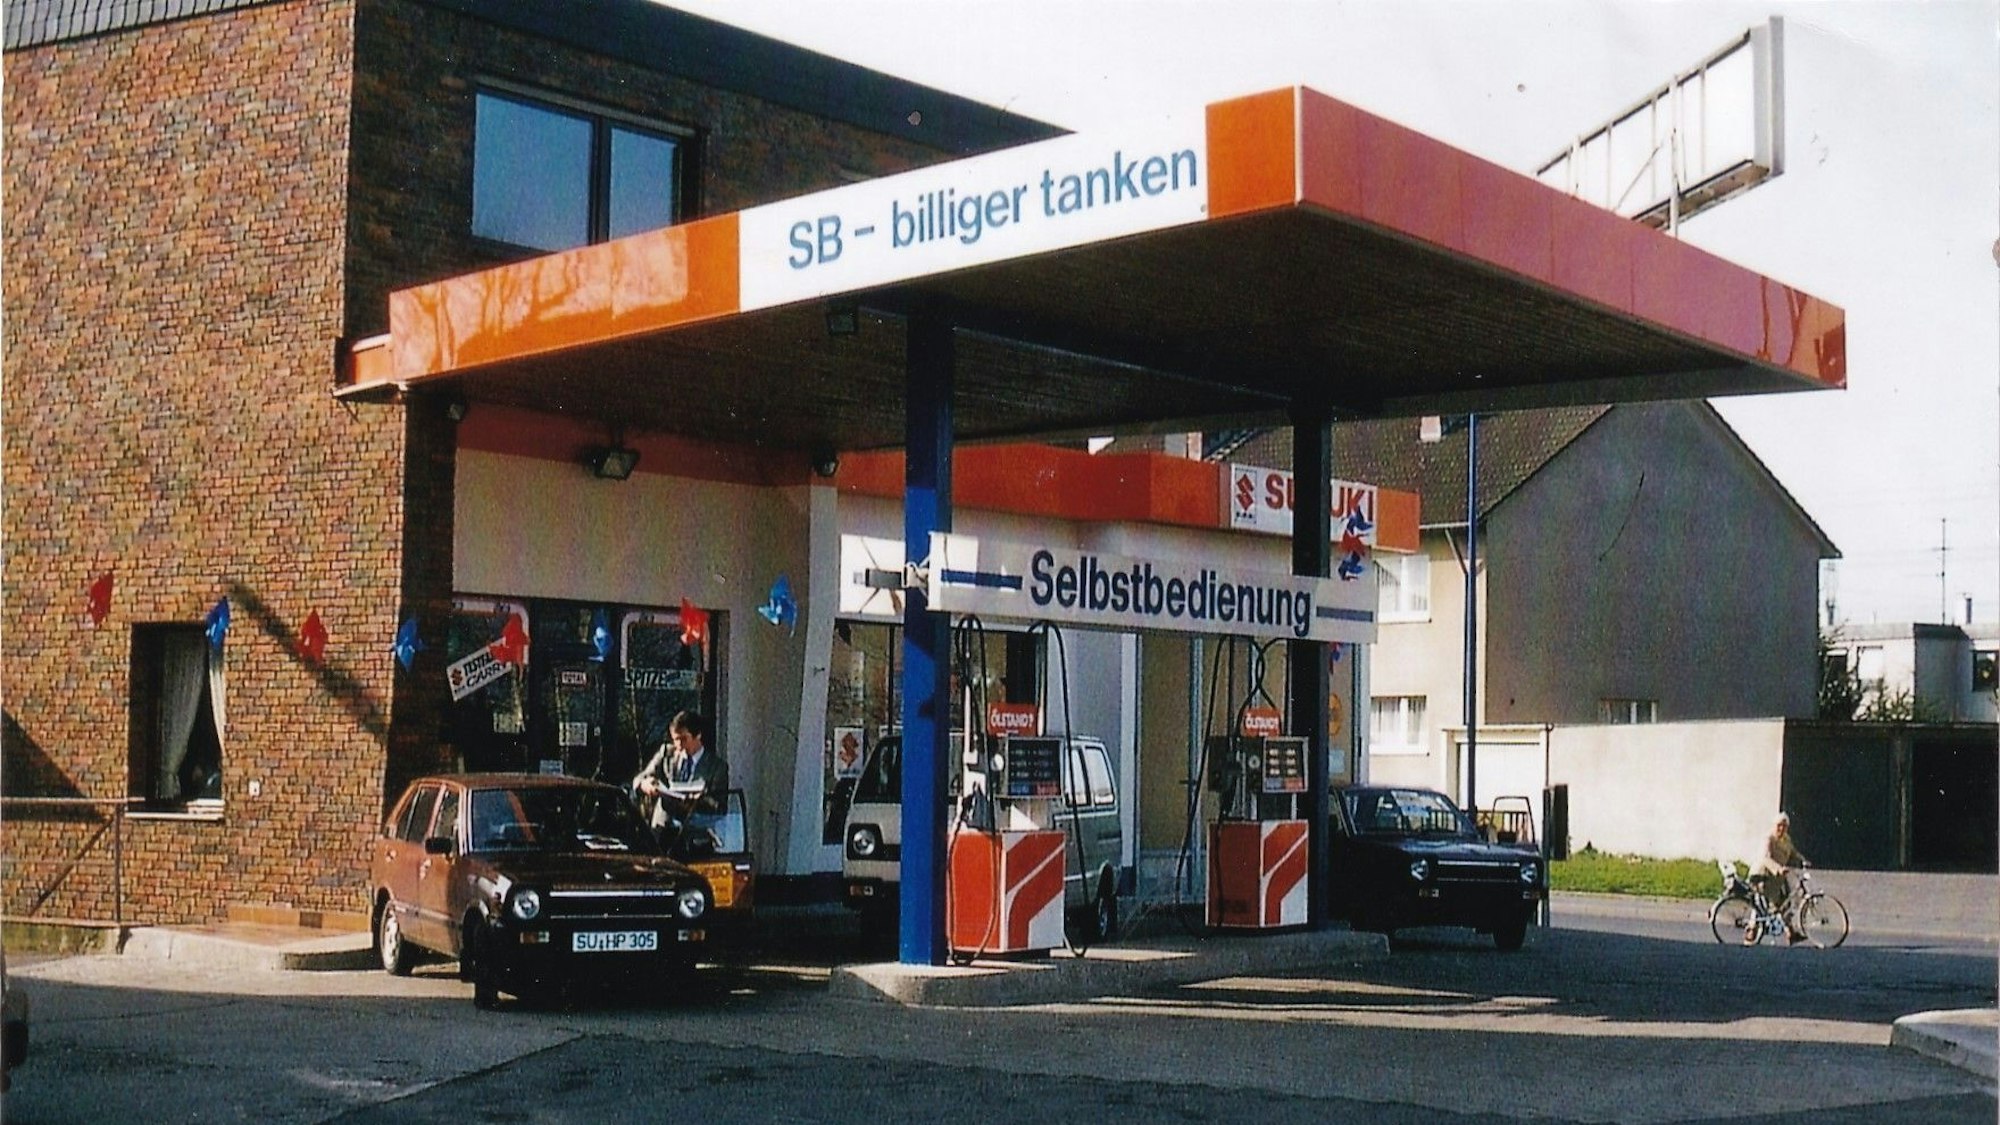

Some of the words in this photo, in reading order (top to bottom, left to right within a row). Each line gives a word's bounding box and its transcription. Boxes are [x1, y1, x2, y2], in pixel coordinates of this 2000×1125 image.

[788, 215, 843, 270] SB
[892, 184, 1027, 245] billiger
[1040, 149, 1197, 217] tanken
[1265, 473, 1375, 522] SUKI
[1030, 550, 1311, 637] Selbstbedienung
[577, 934, 598, 949] SU
[606, 934, 626, 949] HP
[629, 933, 654, 948] 305
